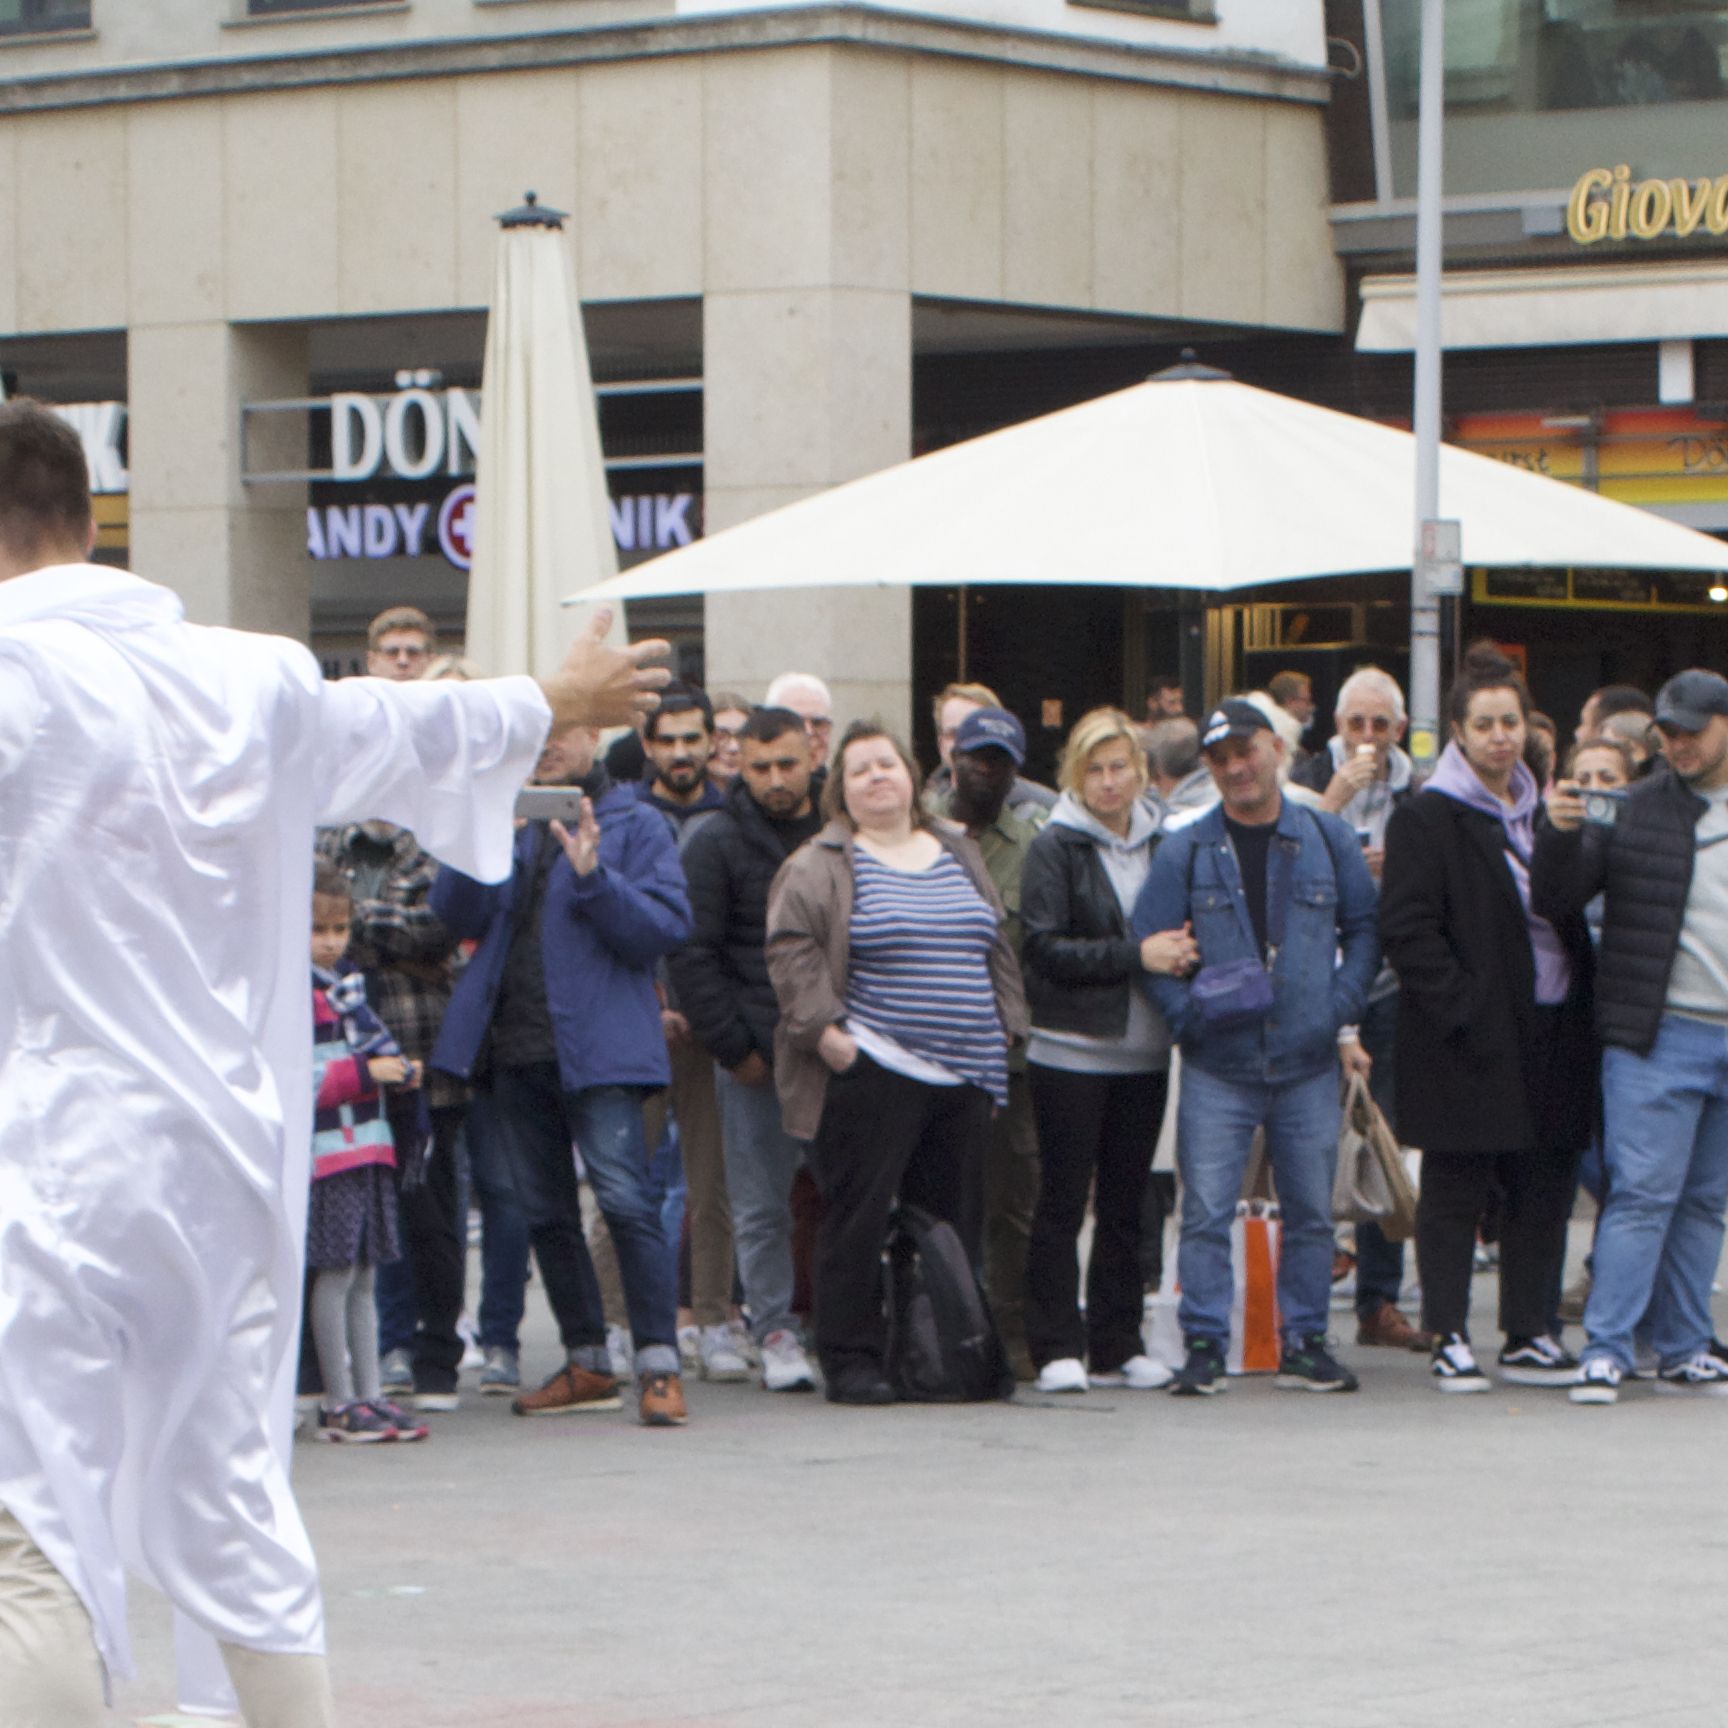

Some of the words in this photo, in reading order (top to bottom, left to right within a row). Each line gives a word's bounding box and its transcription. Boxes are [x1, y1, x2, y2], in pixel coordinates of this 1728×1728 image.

[329, 368, 482, 482] DÖN
[307, 501, 431, 560] ANDY
[610, 492, 695, 552] NIK
